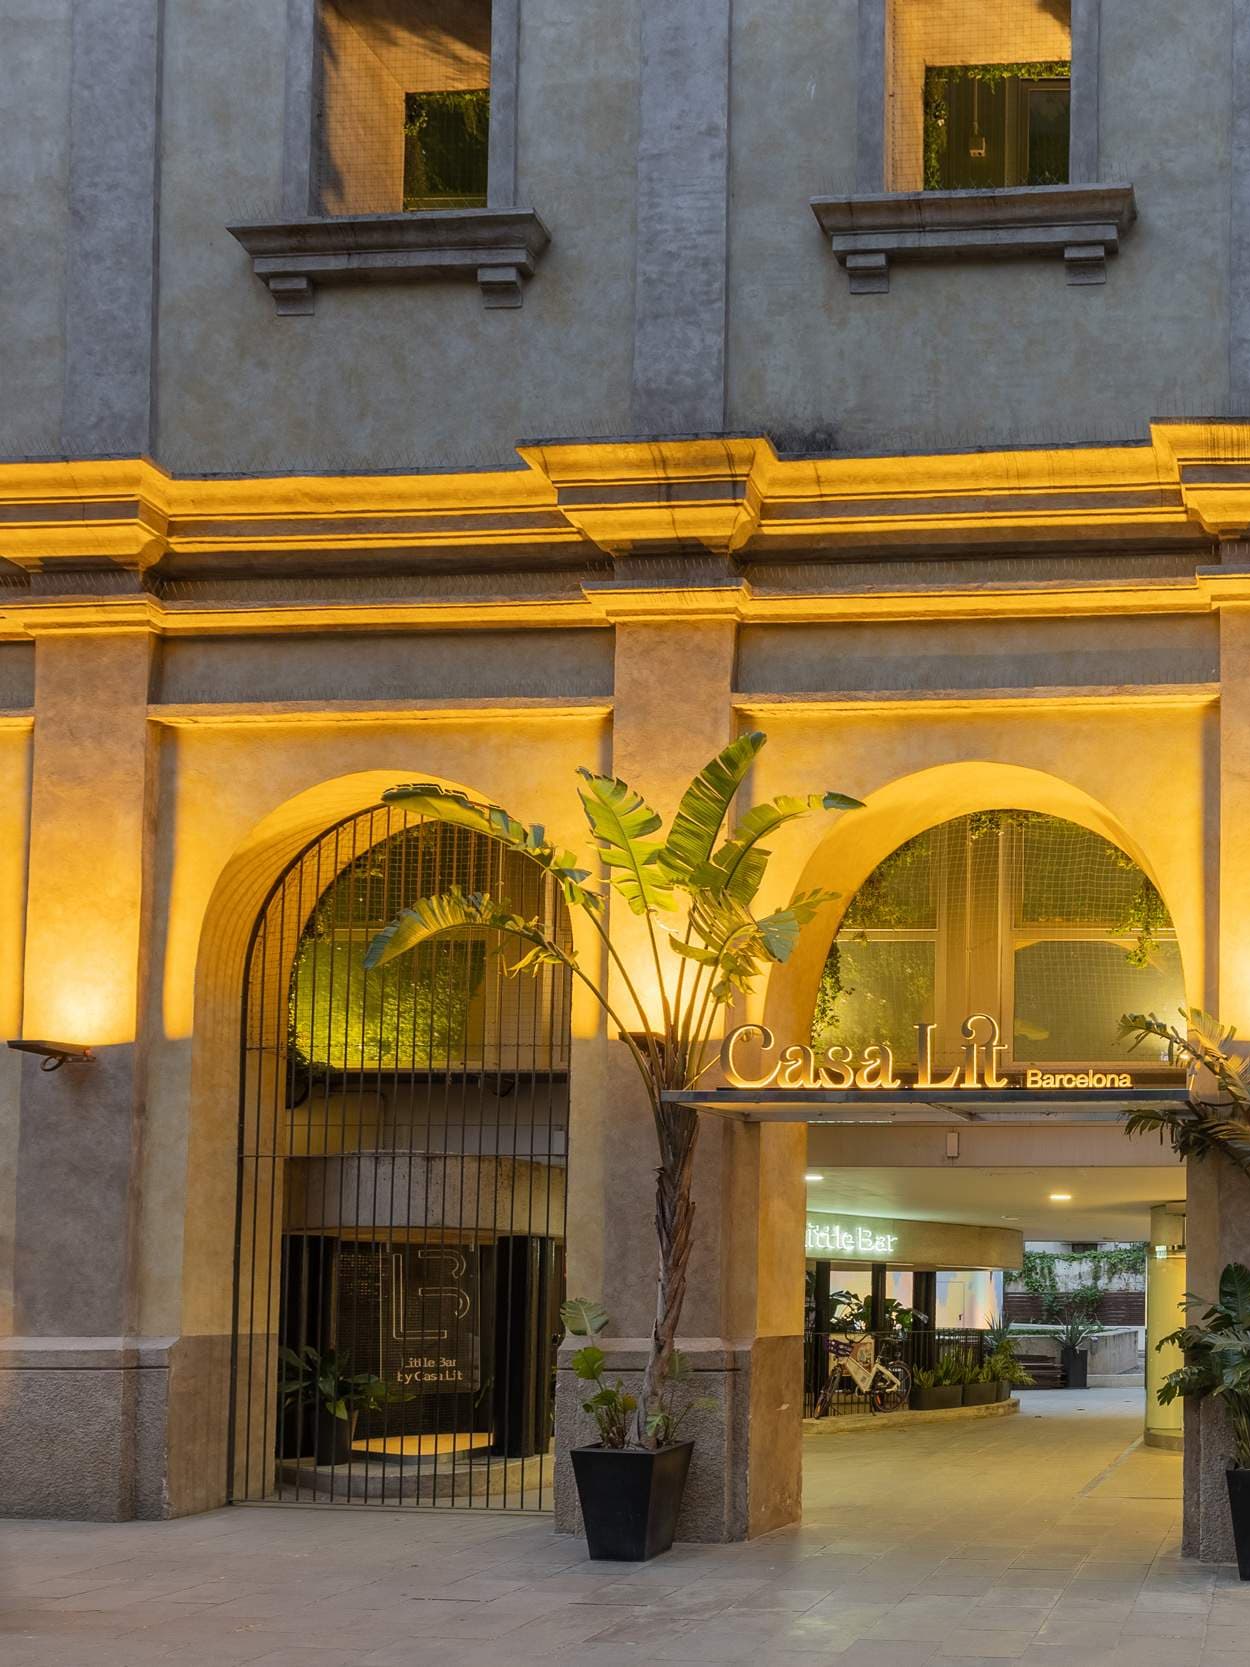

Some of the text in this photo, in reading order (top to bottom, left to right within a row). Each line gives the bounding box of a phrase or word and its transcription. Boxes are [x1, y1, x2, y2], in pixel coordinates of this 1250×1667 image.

[720, 1015, 1132, 1089] Casa Lit Barcelona
[805, 1222, 898, 1252] ittle Bar
[445, 1370, 463, 1380] Lit
